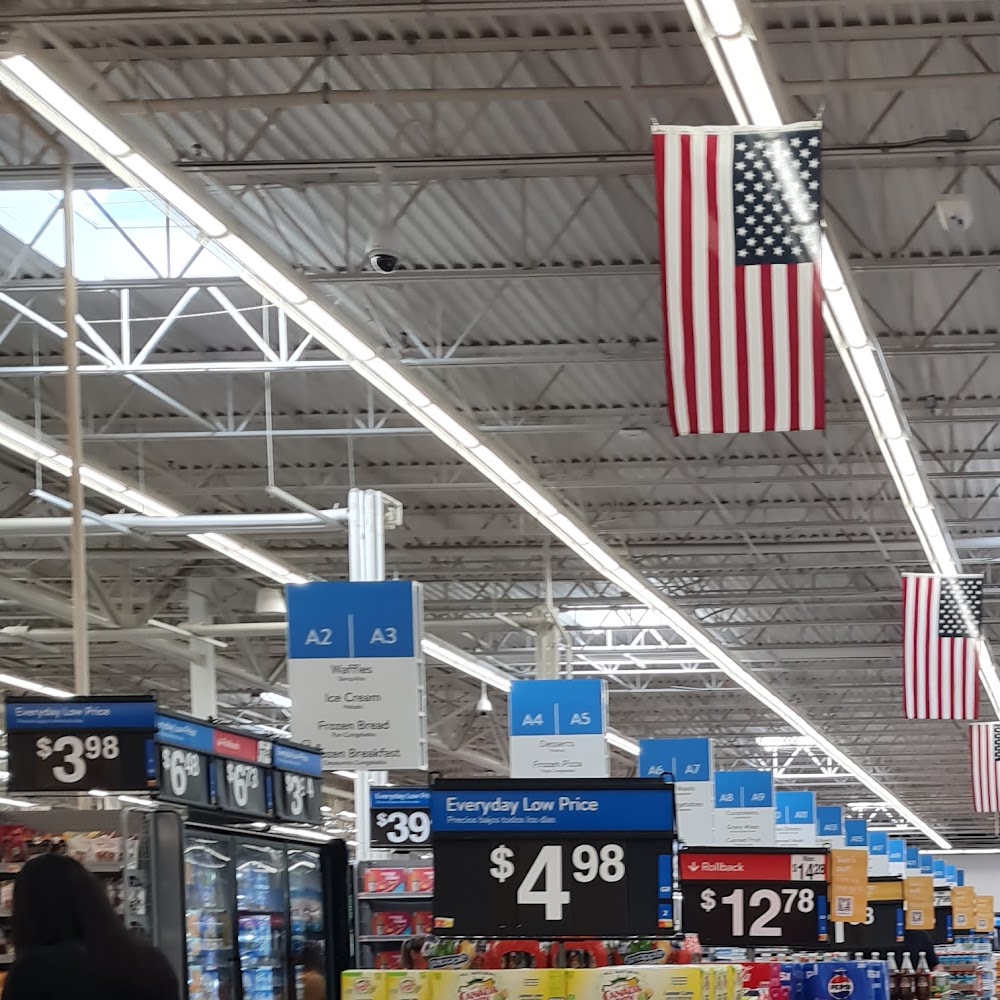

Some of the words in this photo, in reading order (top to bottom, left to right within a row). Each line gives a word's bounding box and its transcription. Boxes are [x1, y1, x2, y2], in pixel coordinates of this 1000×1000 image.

[304, 628, 332, 646] A2
[369, 627, 397, 644] A3
[324, 693, 342, 702] Ice
[344, 692, 381, 702] Cream
[521, 714, 544, 726] A4
[570, 712, 592, 726] A5
[684, 764, 701, 774] A7
[446, 797, 520, 816] Everyday
[522, 798, 555, 812] Low
[558, 796, 600, 812] Price
[701, 862, 745, 872] Rollback
